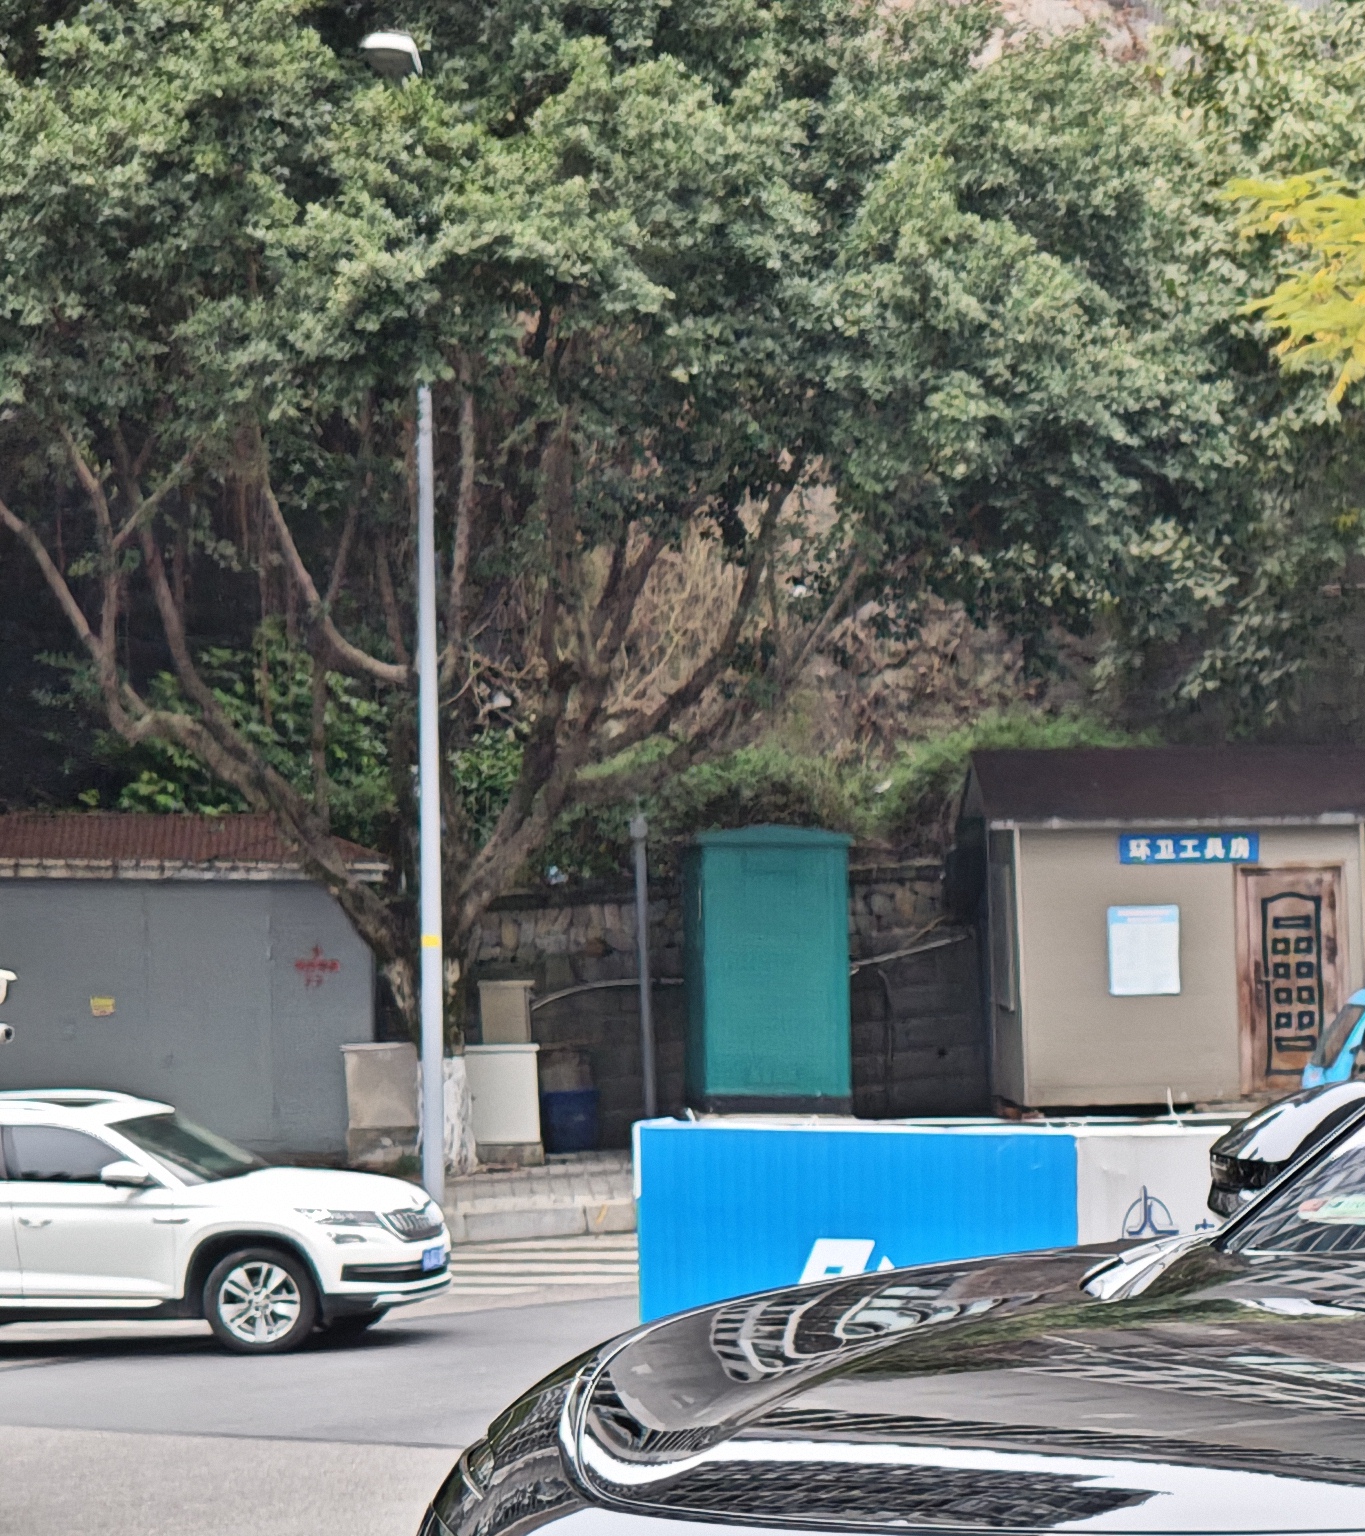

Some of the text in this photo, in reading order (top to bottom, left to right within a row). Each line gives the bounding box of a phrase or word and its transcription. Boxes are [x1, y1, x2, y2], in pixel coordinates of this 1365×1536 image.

[1128, 837, 1250, 861] 环卫工具房
